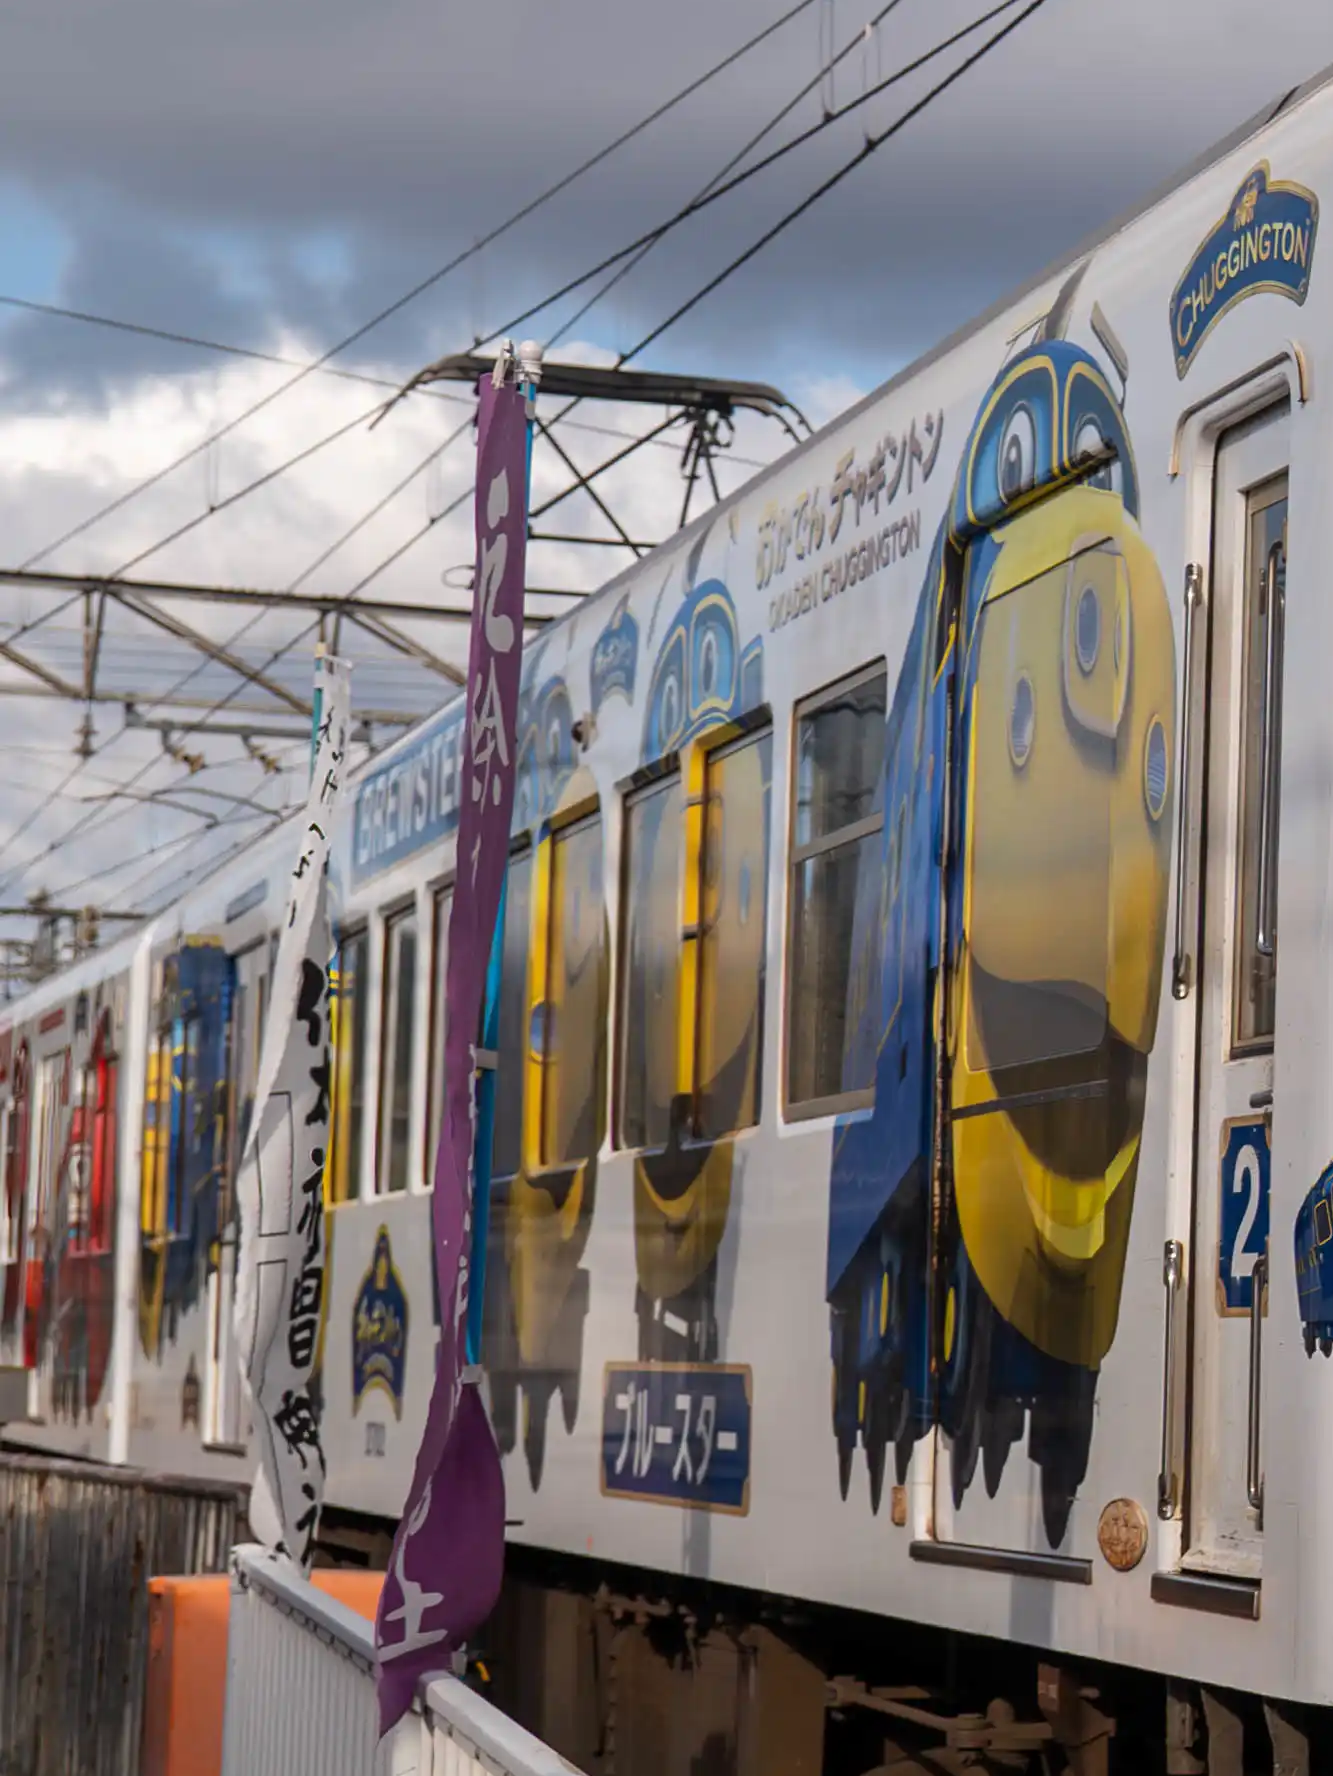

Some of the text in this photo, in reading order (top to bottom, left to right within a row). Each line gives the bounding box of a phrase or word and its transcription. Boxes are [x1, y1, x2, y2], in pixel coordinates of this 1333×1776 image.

[1177, 222, 1309, 347] CHUGGINGTON
[821, 508, 921, 603] CHUGGINGTON
[615, 1380, 738, 1486] ブルースター
